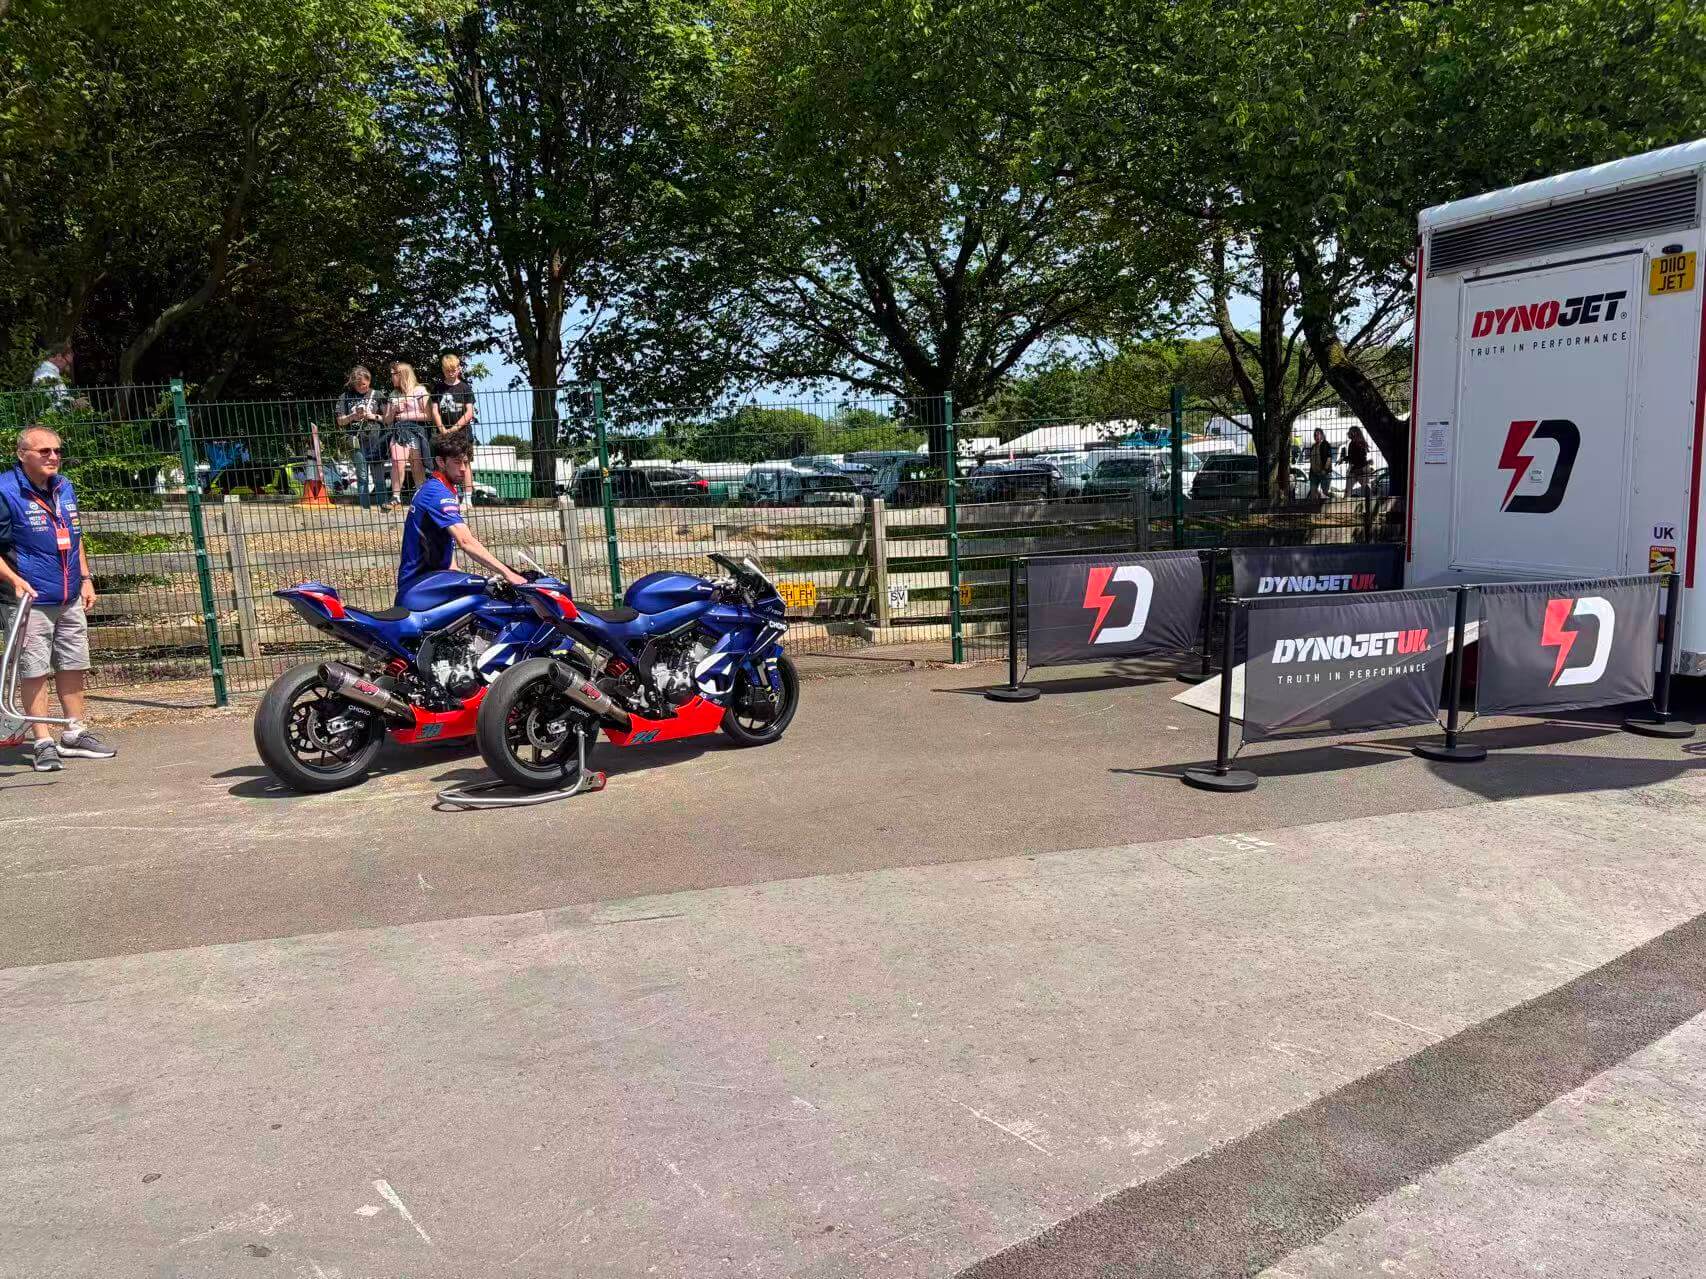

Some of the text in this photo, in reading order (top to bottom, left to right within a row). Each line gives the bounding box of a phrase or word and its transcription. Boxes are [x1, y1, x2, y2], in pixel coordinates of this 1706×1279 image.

[1657, 273, 1686, 291] JET
[1471, 331, 1628, 357] TRUTH IN PERFORMANCE
[1653, 526, 1674, 540] UK
[800, 589, 813, 600] FH
[890, 590, 905, 601] SV
[1277, 662, 1427, 685] TRUTH IN PERFORMANCE
